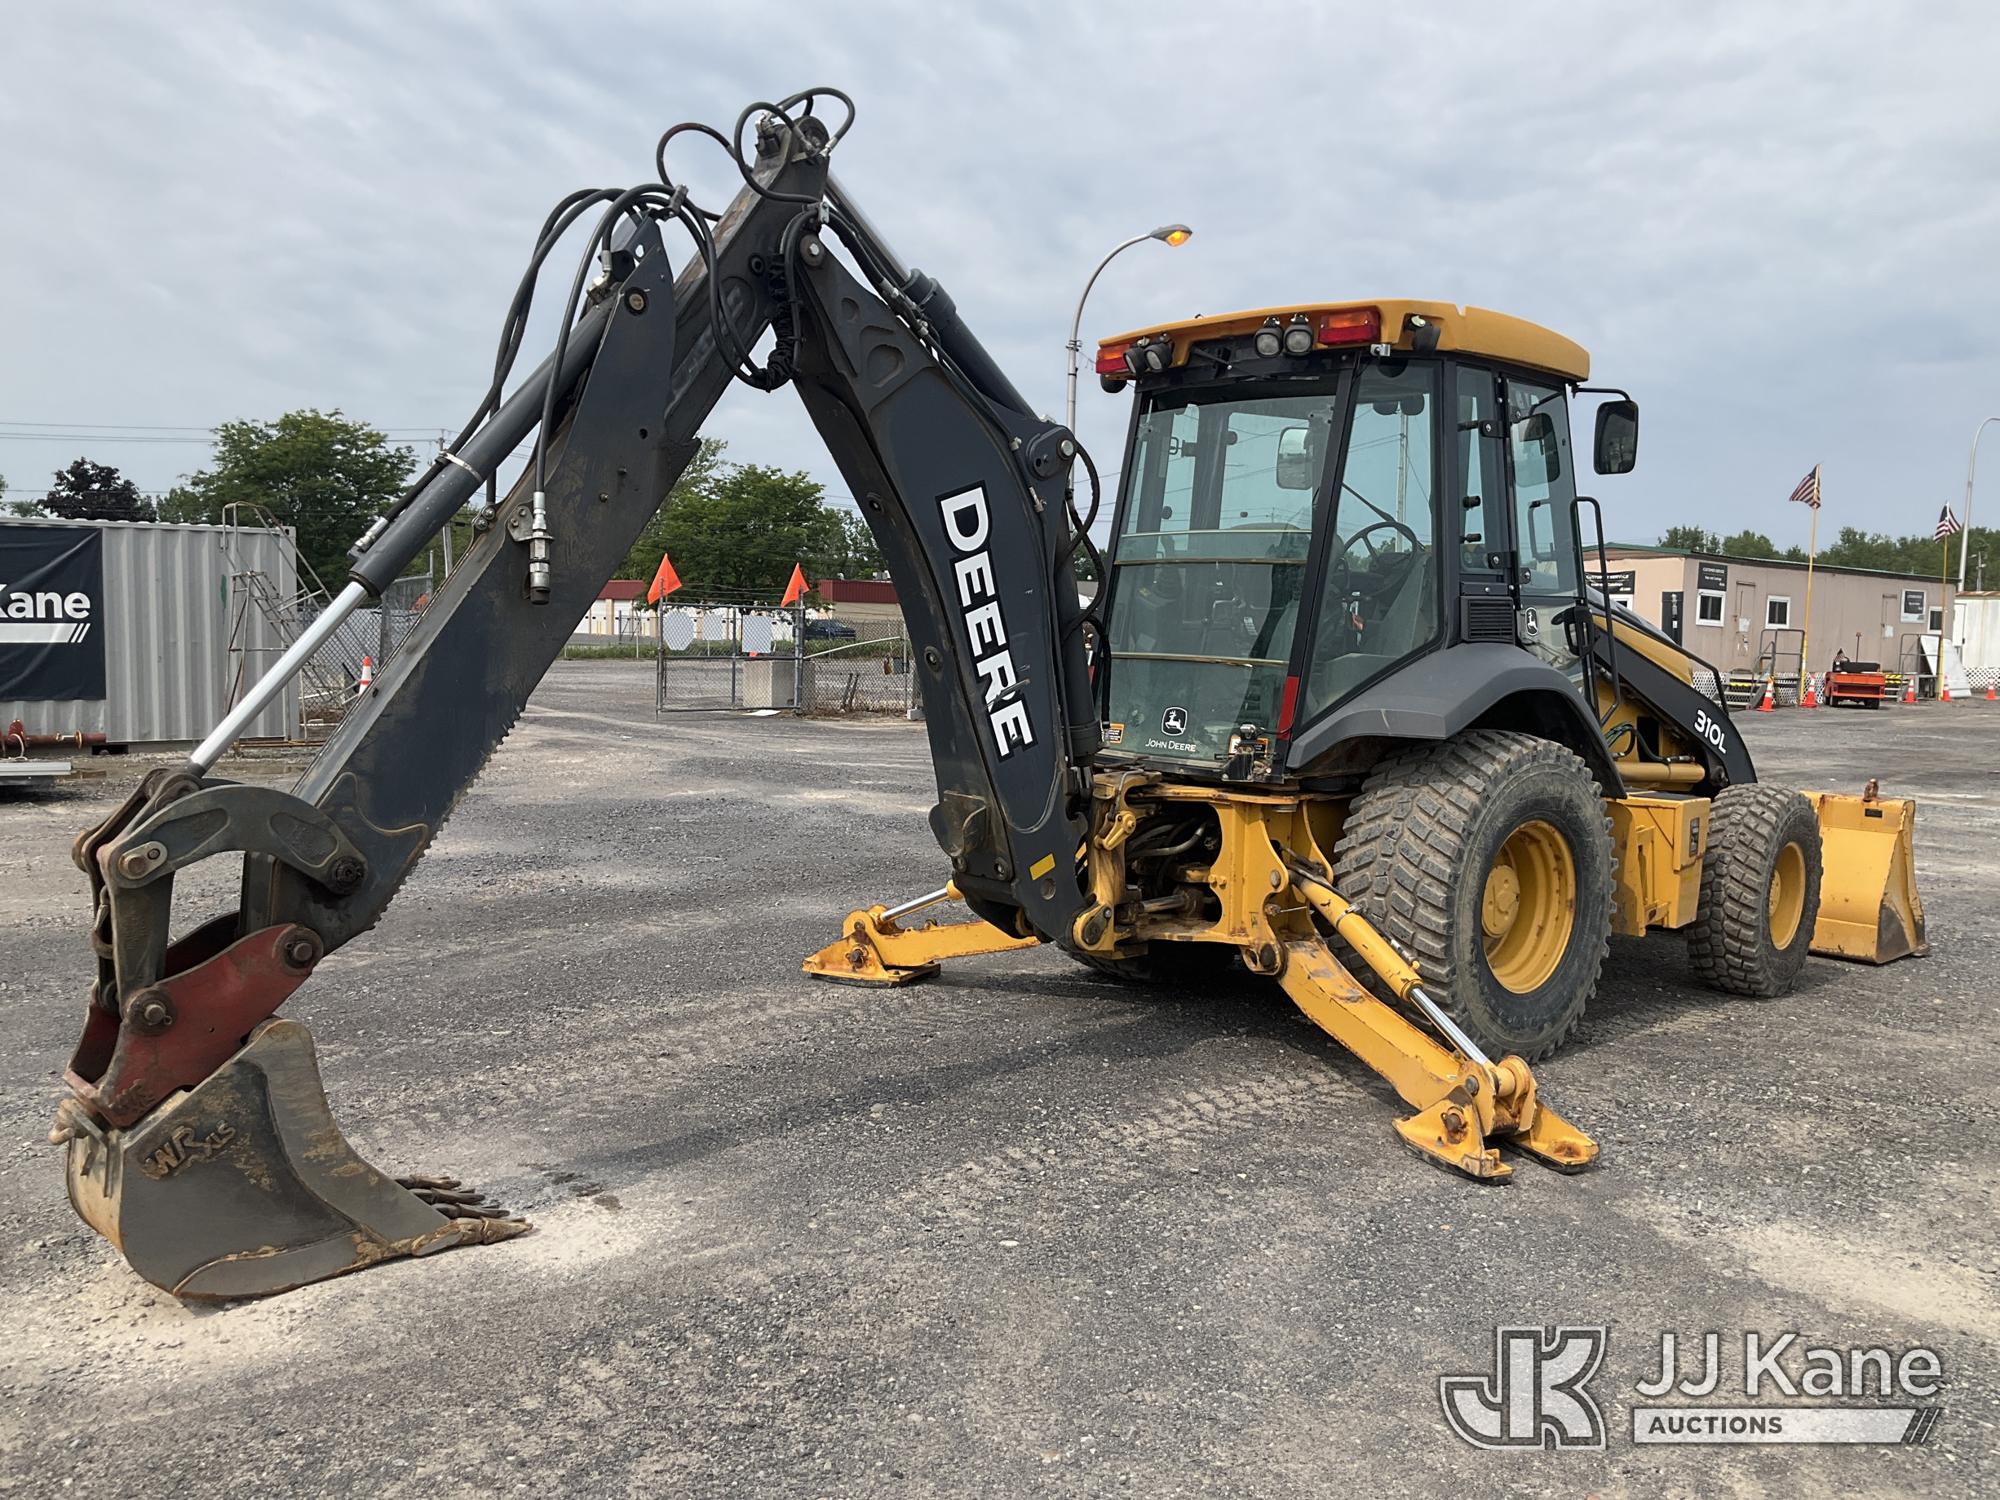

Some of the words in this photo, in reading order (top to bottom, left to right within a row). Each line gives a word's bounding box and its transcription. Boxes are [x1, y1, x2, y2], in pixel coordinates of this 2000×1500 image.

[940, 486, 1034, 757] DEERE
[1145, 738, 1167, 749] JOHN
[1168, 740, 1197, 752] DEERE
[1694, 709, 1727, 754] 310L
